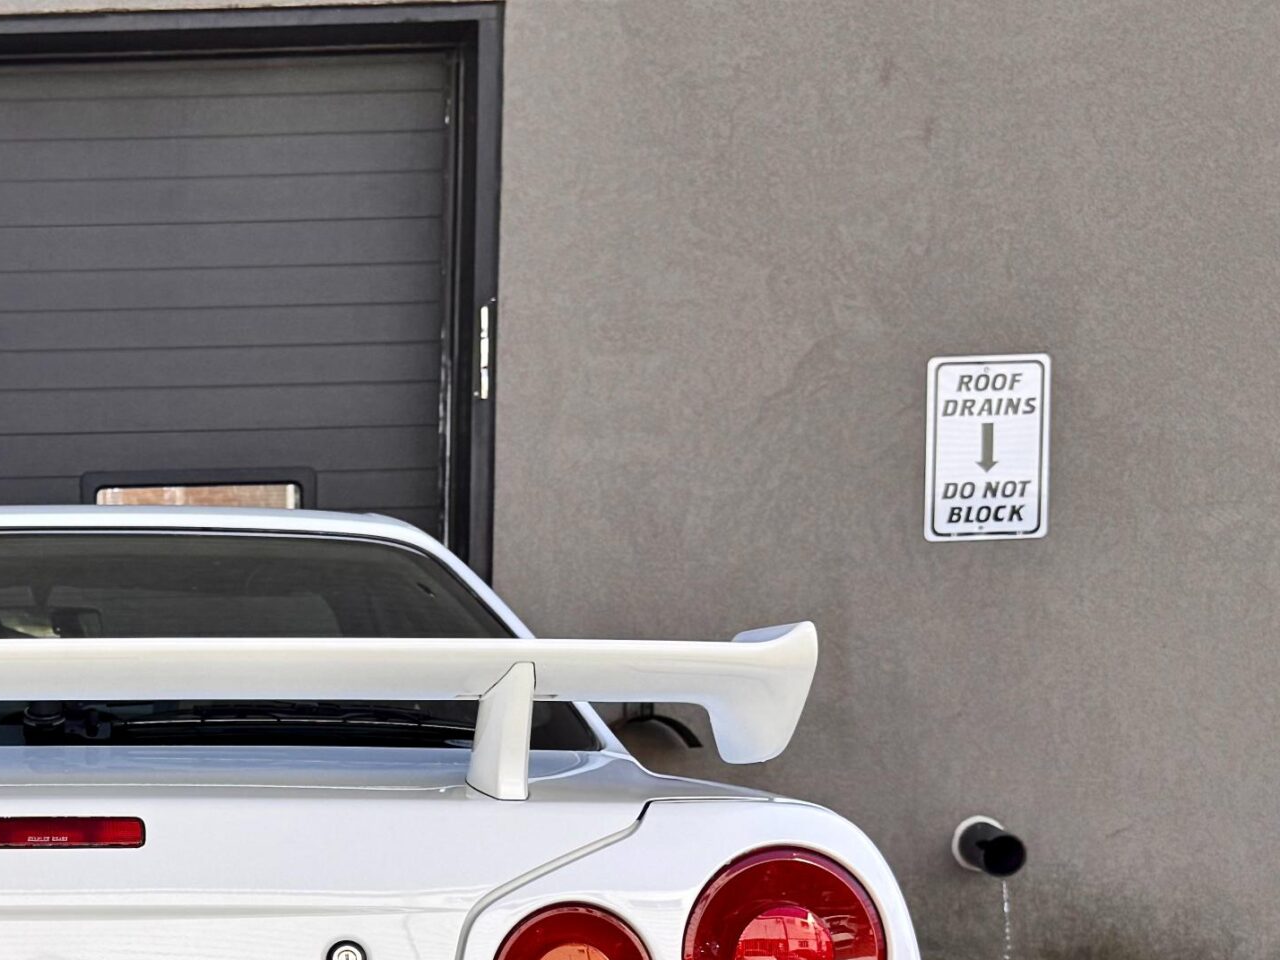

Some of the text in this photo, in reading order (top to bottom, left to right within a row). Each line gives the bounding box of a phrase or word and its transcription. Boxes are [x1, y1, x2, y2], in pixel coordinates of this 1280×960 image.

[956, 373, 1023, 392] ROOF
[942, 397, 1037, 417] DRAINS
[942, 480, 1031, 500] DO NOT
[947, 505, 1026, 523] BLOCK
